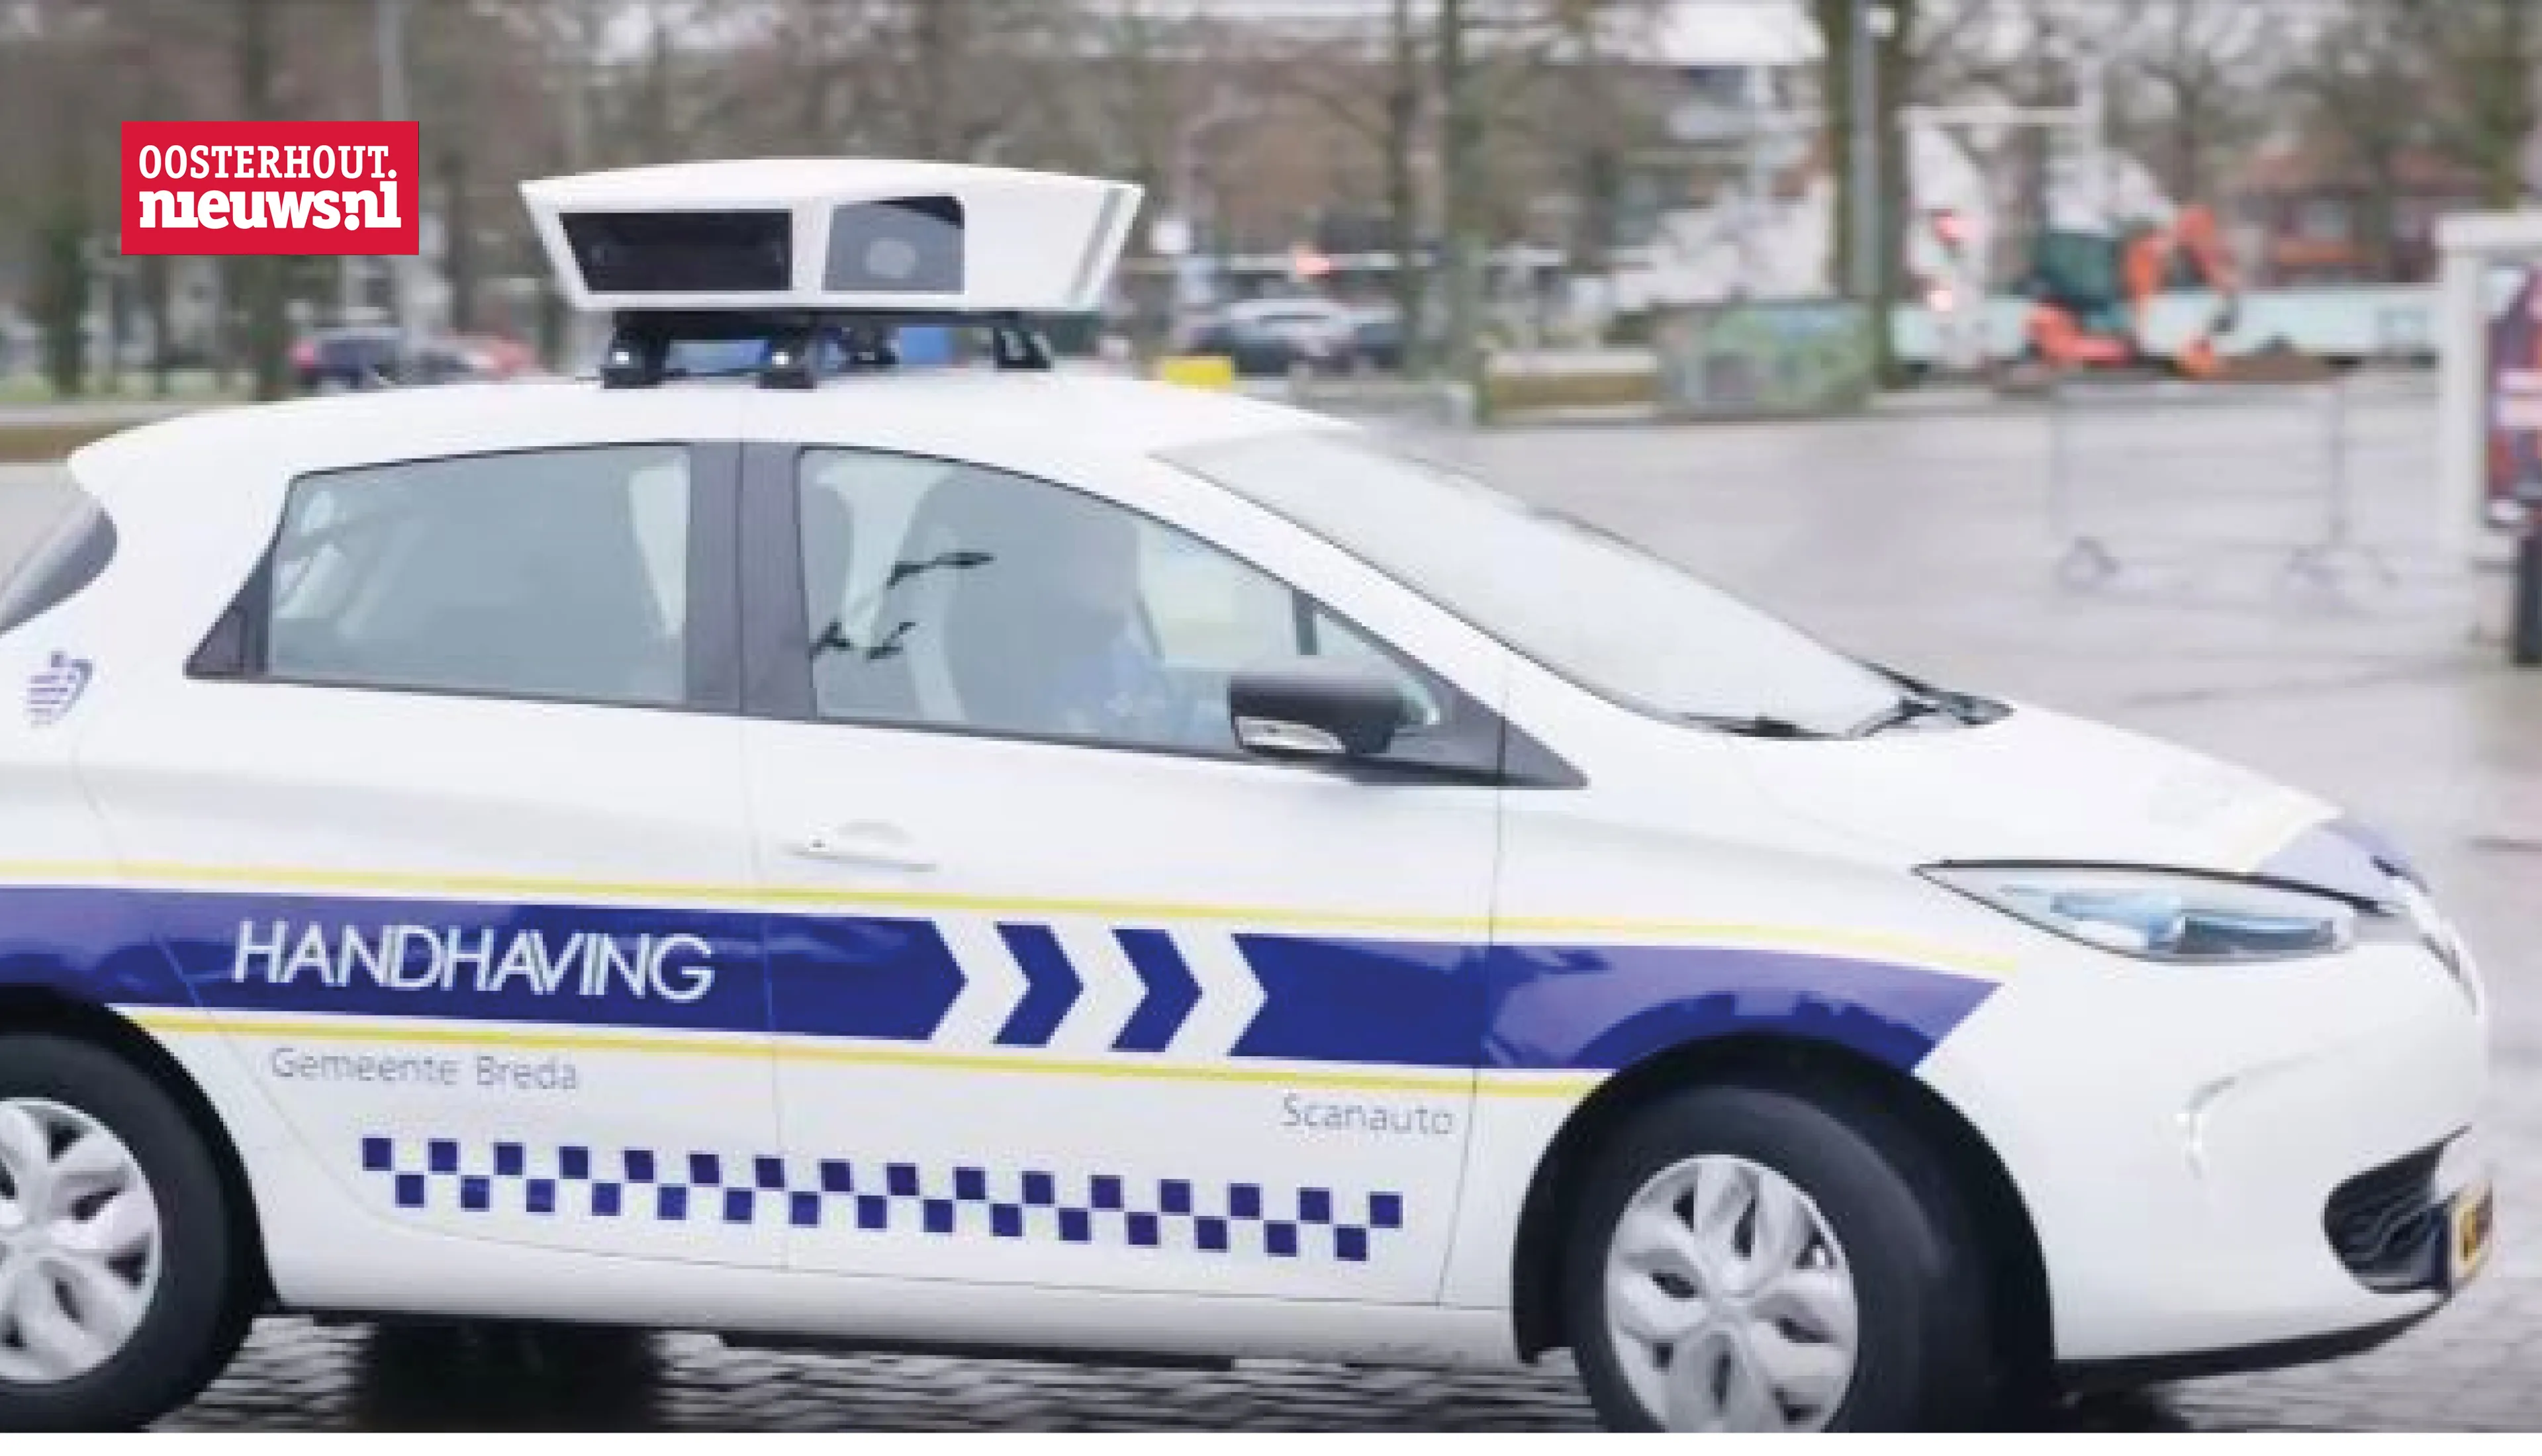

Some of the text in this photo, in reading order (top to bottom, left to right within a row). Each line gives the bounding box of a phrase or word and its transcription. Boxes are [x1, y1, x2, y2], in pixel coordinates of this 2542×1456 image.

[232, 919, 716, 1003] HANDHAVING
[270, 1046, 579, 1091] Gemeente Breda
[1280, 1091, 1455, 1135] Scanauto
